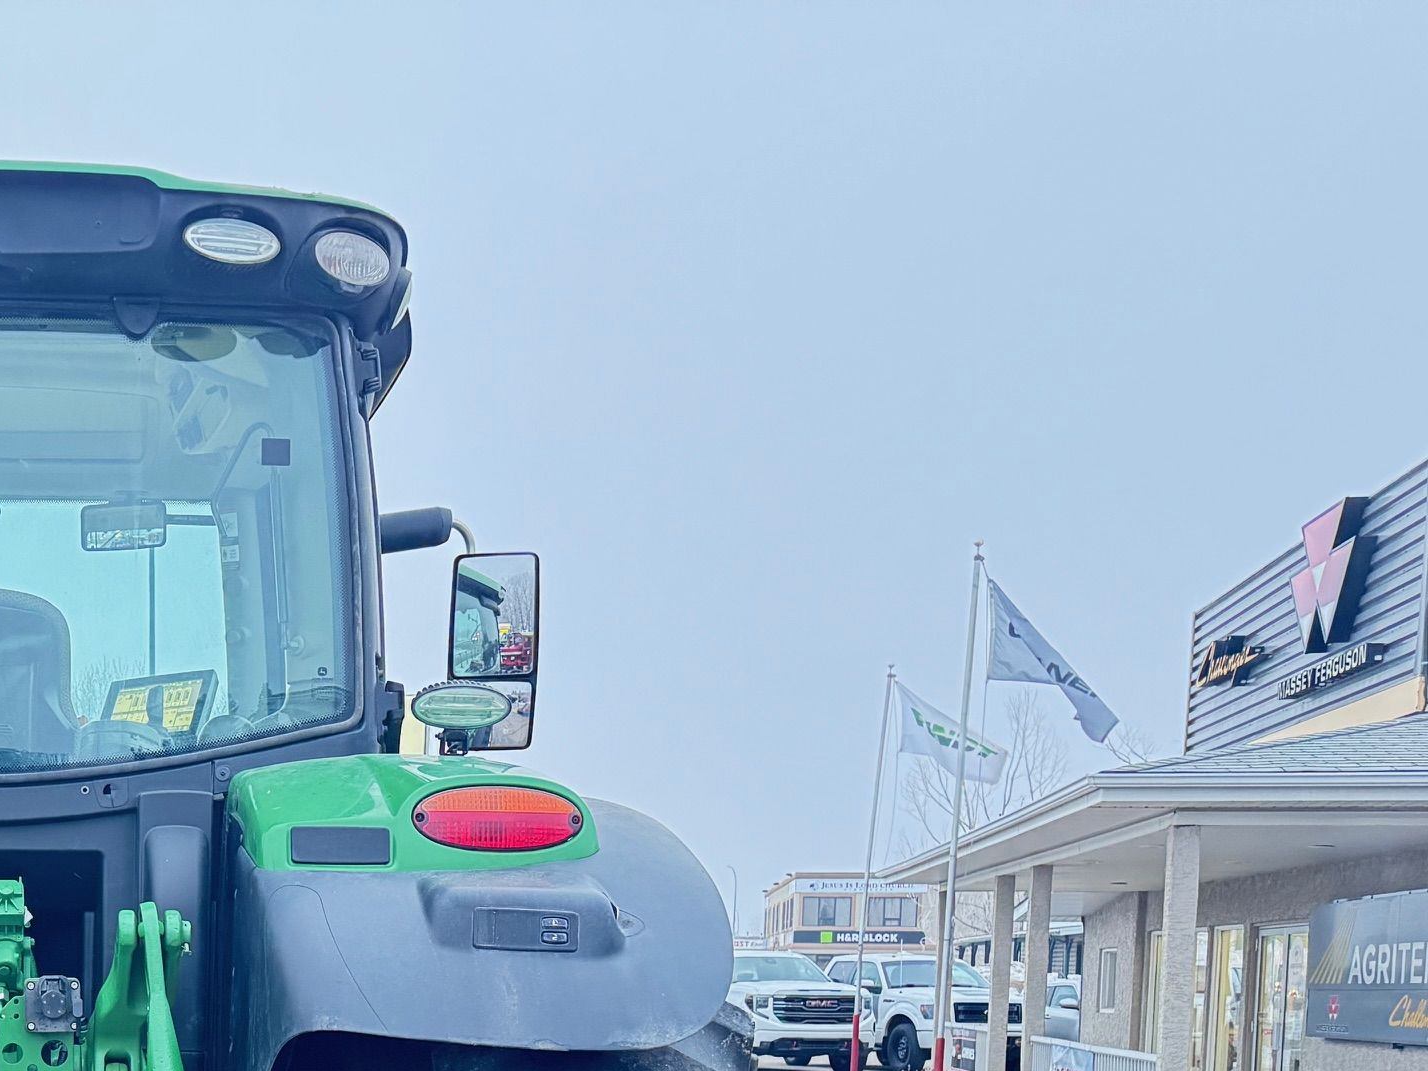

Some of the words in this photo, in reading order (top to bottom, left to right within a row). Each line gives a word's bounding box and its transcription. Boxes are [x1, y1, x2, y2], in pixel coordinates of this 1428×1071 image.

[1277, 669, 1313, 700] MASSEY
[1314, 643, 1368, 685] FERGUSON
[1347, 942, 1428, 985] AGRITE
[805, 1000, 838, 1008] GMC
